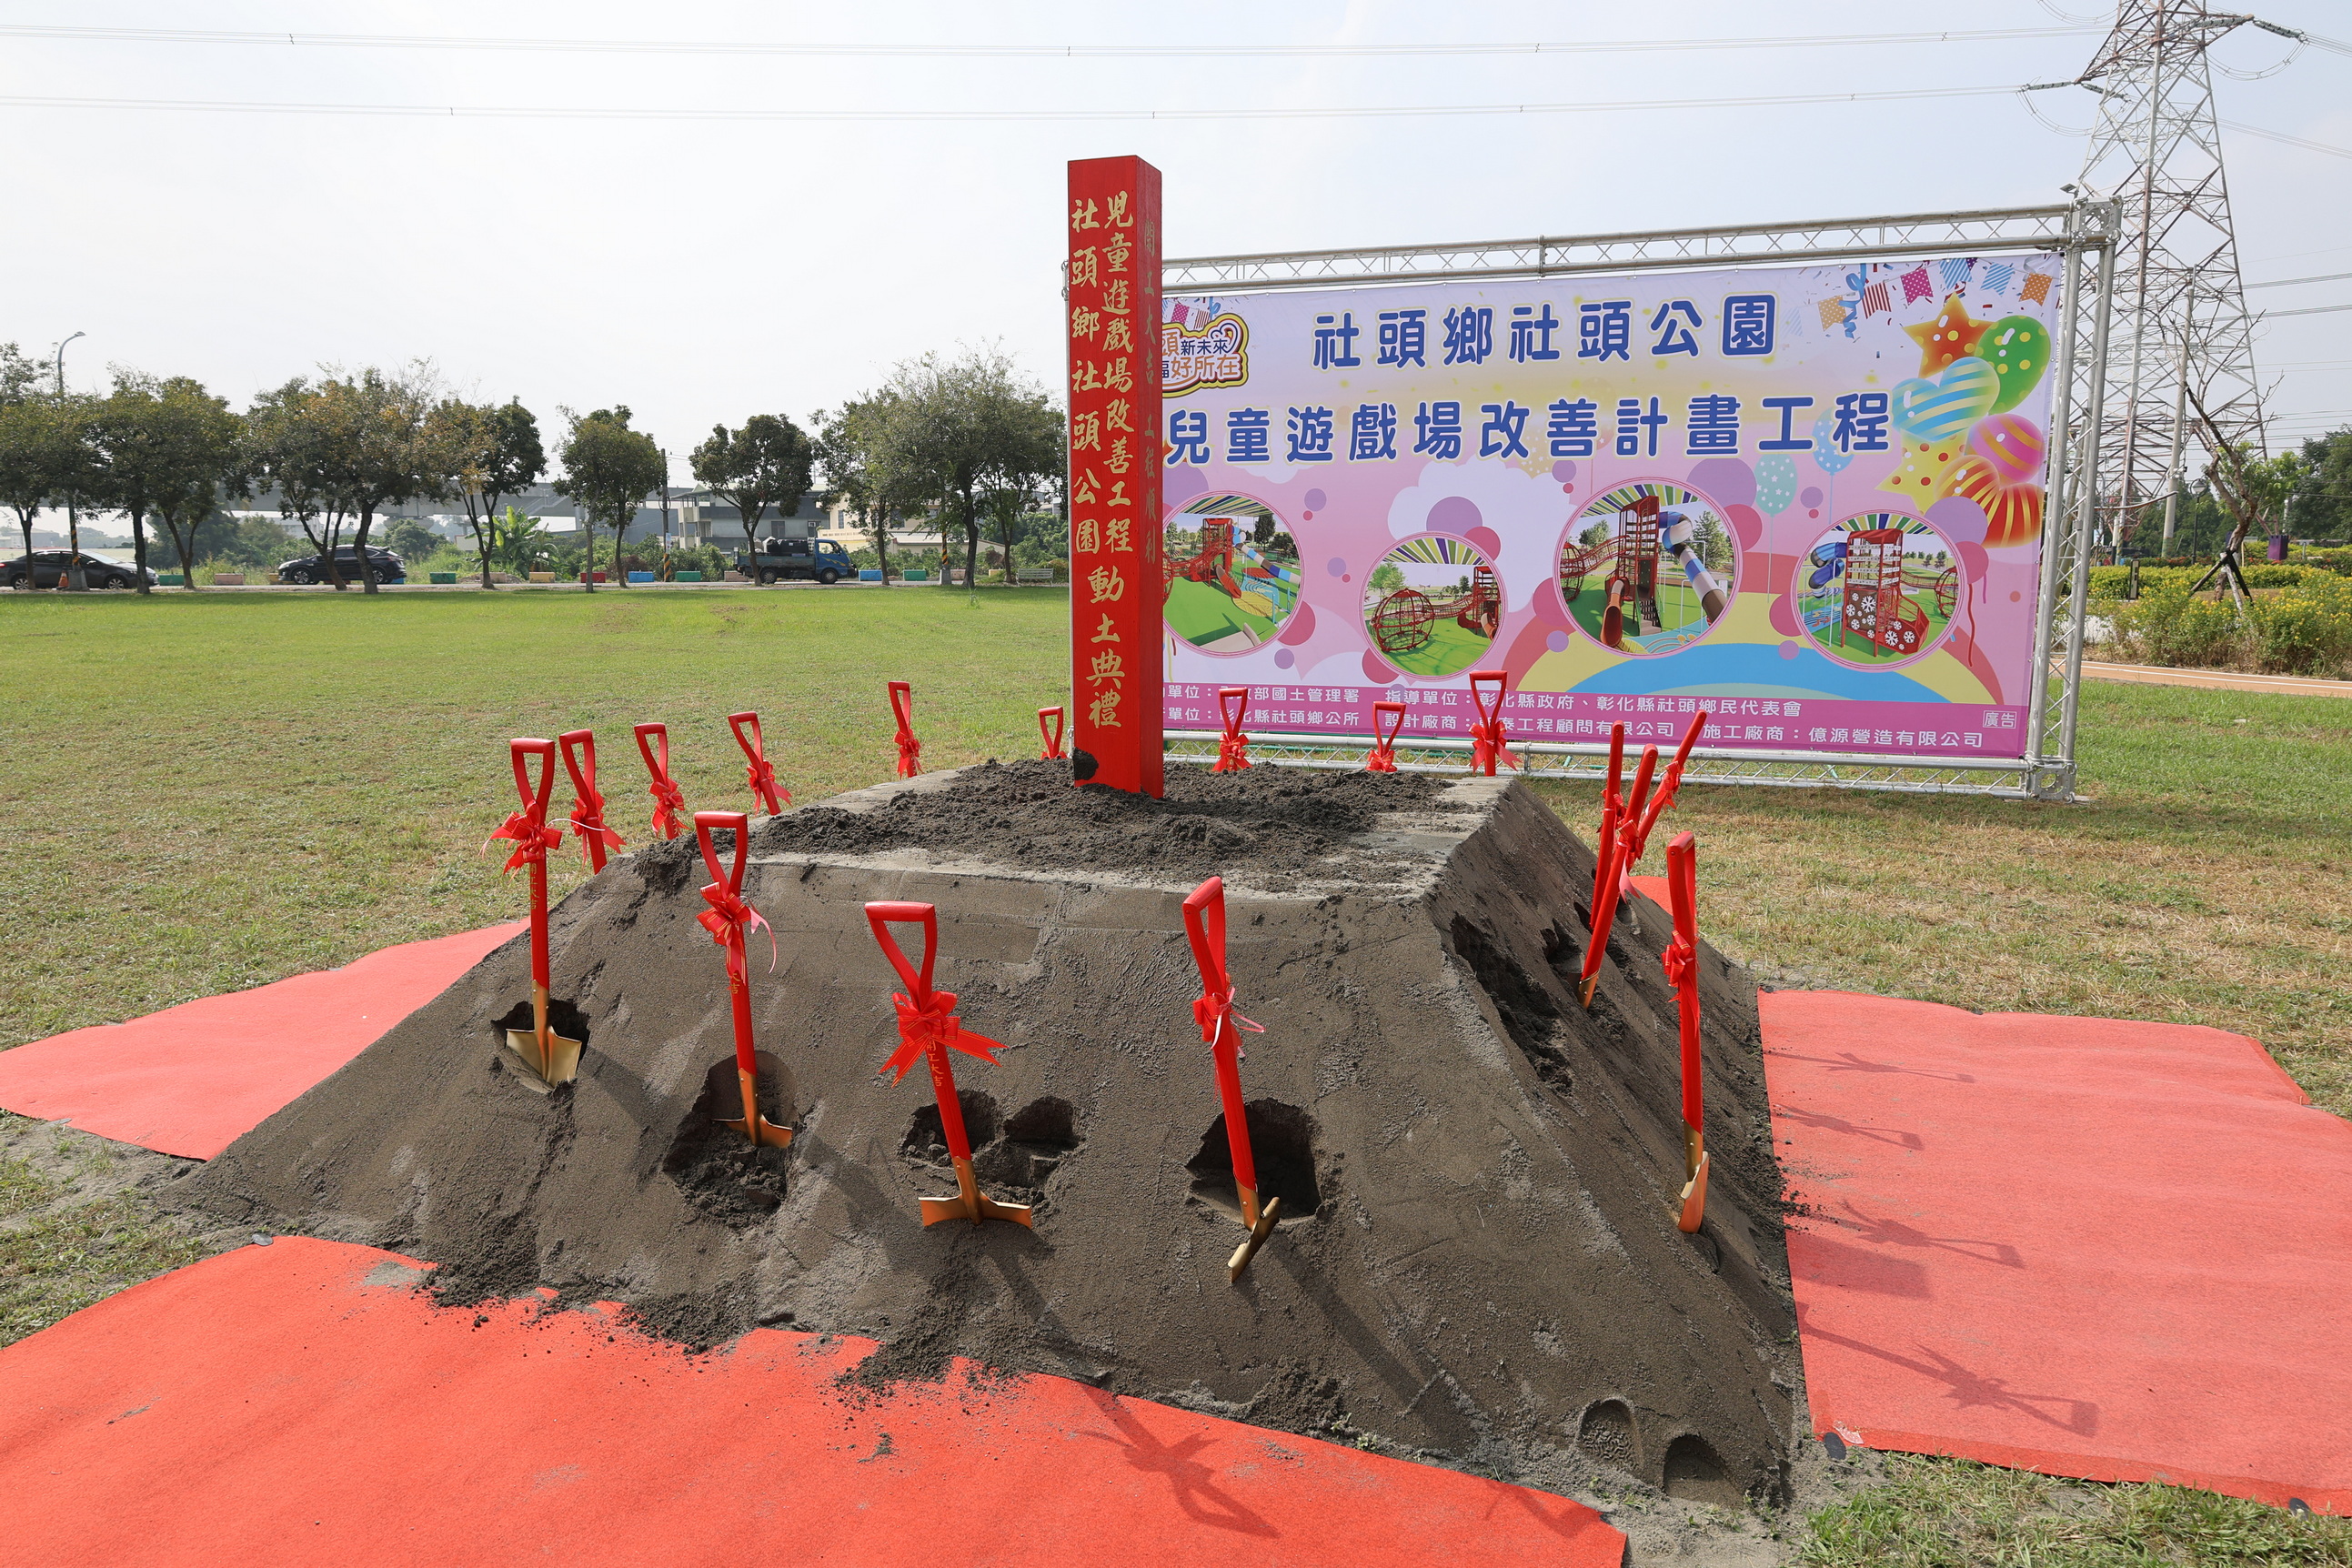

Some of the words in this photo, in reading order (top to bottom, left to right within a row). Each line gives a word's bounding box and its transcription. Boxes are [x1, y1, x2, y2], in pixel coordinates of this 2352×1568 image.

[1313, 293, 1775, 370] 社頭鄉社頭公園
[1070, 197, 1102, 555] 社頭鄉社頭公園
[1167, 392, 1890, 465] 兒童遊戲場改善計畫工程
[1085, 565, 1126, 729] 動土典禮
[1984, 711, 2015, 728] 廣告
